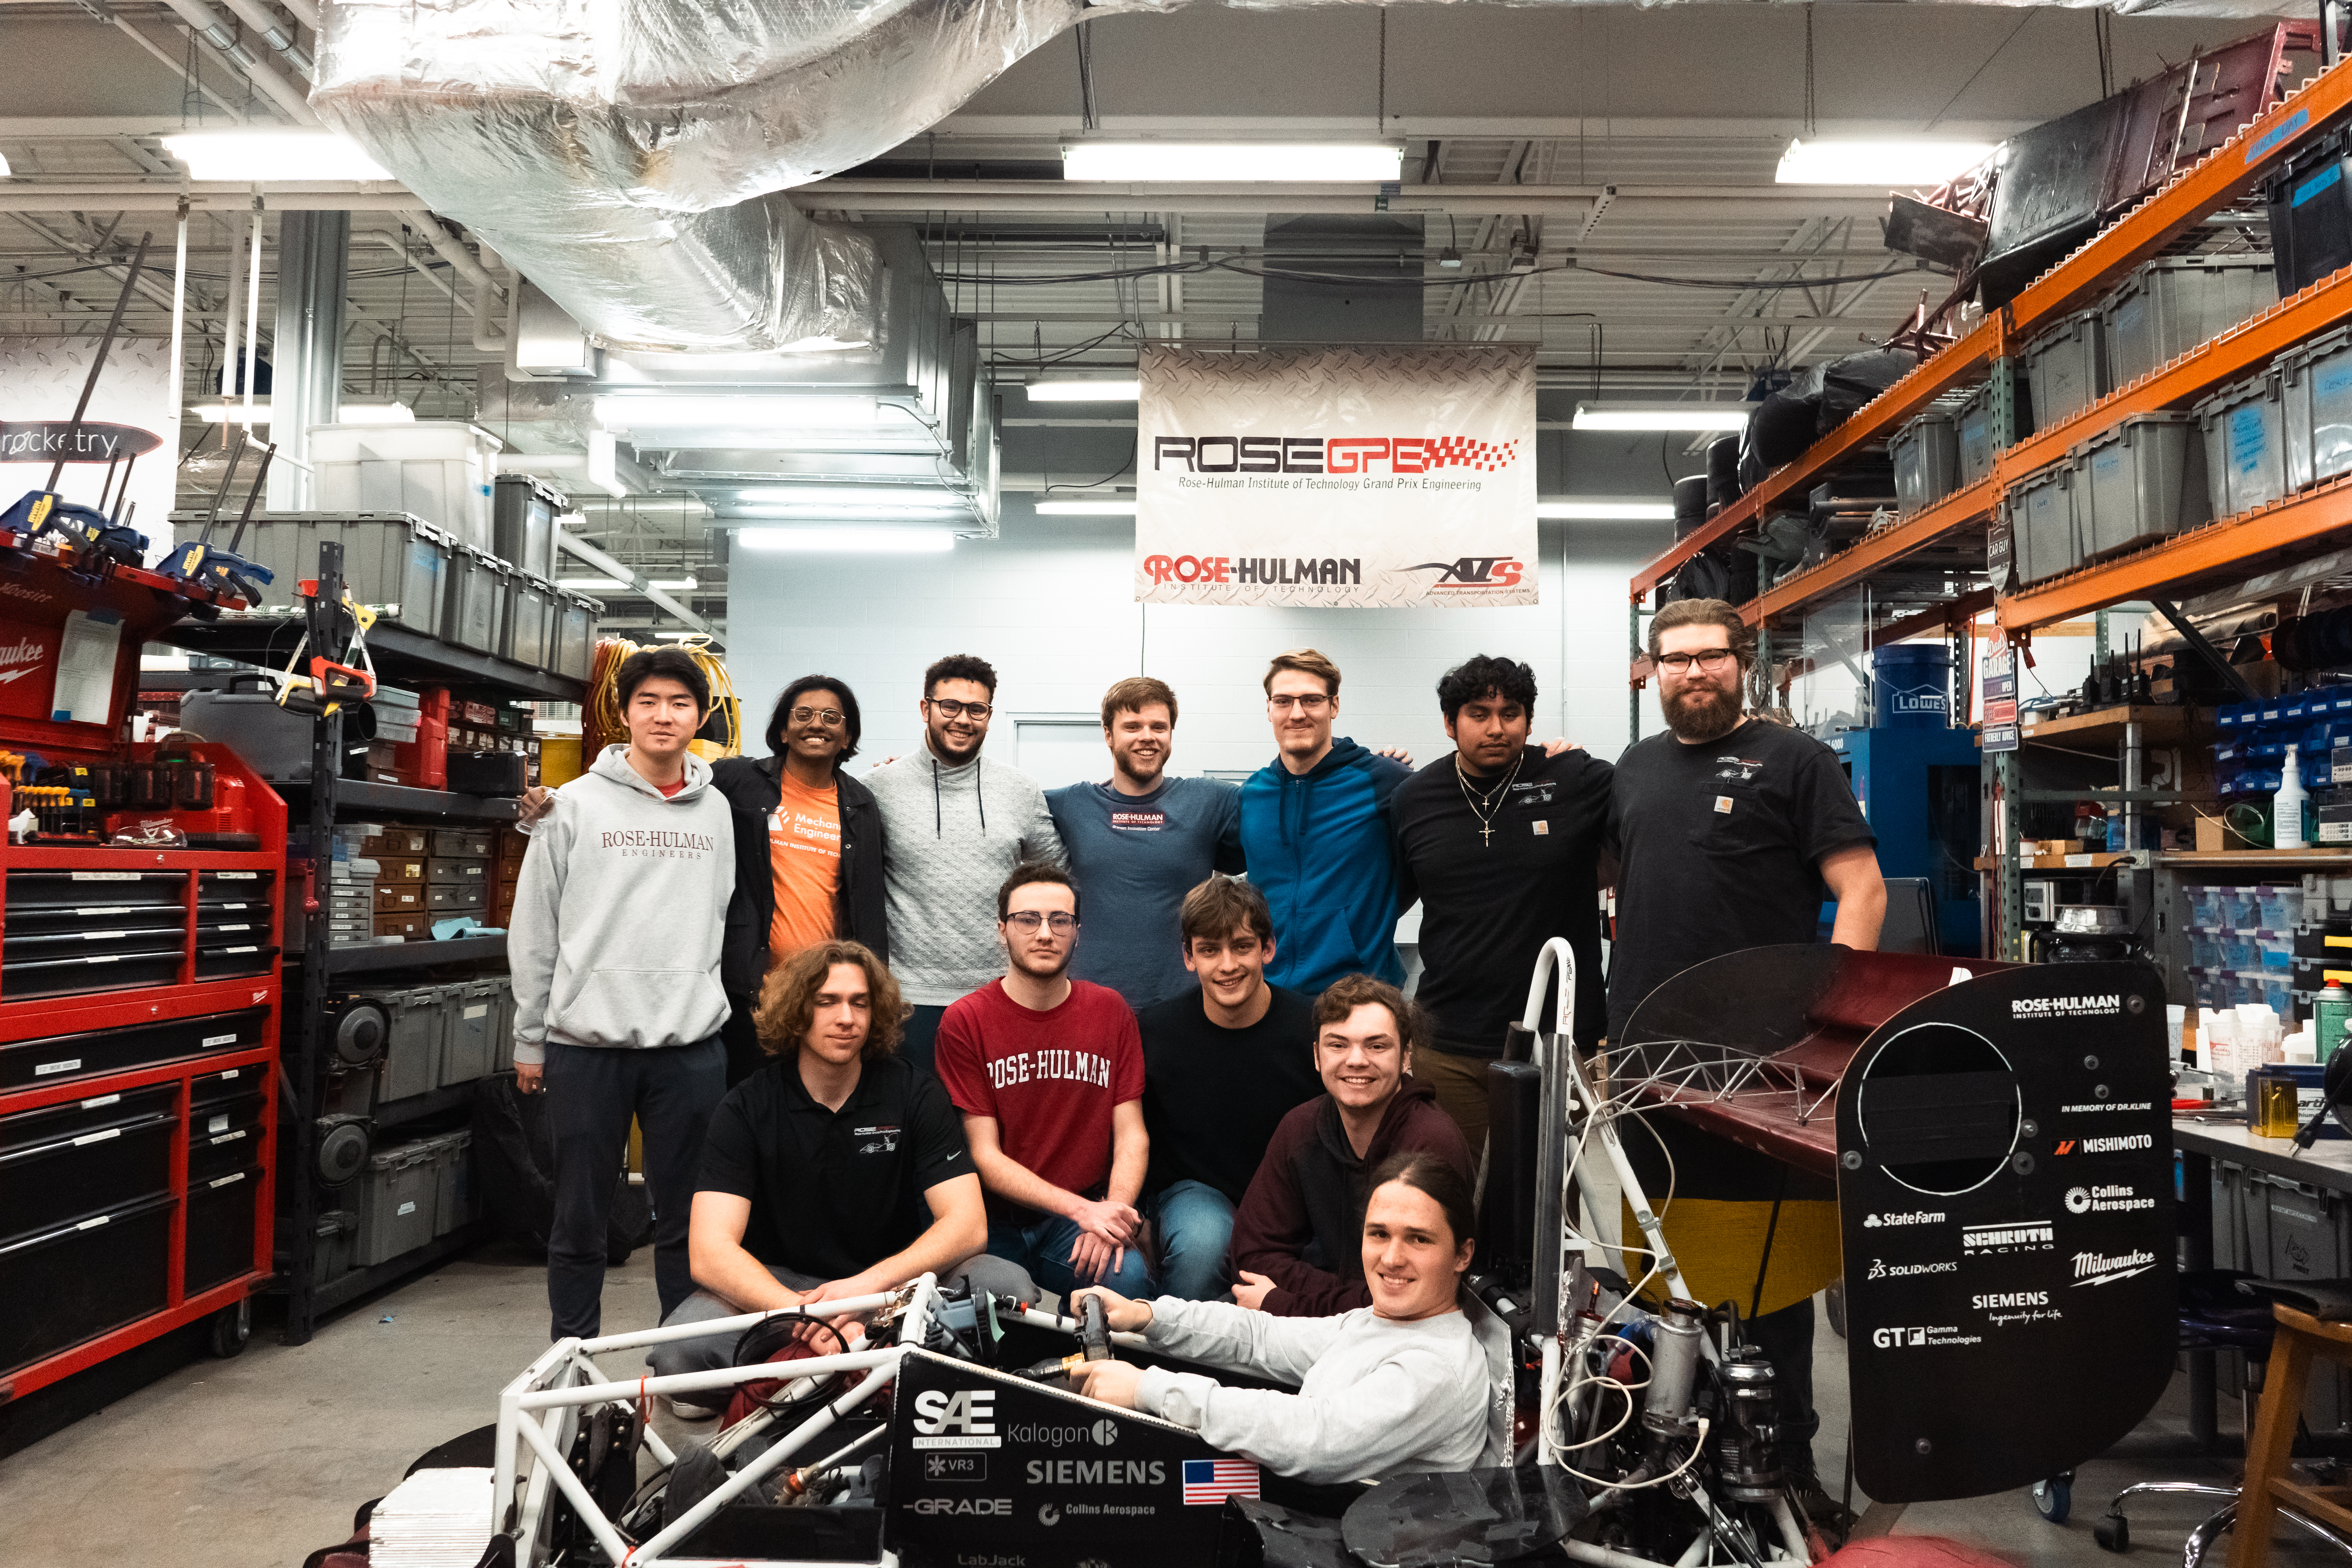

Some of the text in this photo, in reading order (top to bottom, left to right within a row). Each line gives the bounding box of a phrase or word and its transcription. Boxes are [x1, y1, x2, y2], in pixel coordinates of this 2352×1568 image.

[1179, 477, 1481, 492] Rose-Hulman Institute of Technology Grand Prix Engineering
[1989, 538, 2009, 557] CAR GUY
[182, 550, 195, 570] IRWIN
[1144, 555, 1361, 585] ROSE-HULMAN
[1164, 584, 1359, 594] INSTITUTE OF TECHNOLOGY
[1987, 632, 2005, 656] Dad's
[1984, 654, 2011, 679] GARAGE
[2002, 681, 2012, 693] OPEN
[1985, 729, 2015, 743] FATHERLY ADVICE
[1831, 738, 1844, 750] 6000
[601, 830, 713, 852] ROSE-HULMAN
[789, 843, 817, 853] INSTITUTE
[622, 849, 702, 860] ENGINEERS
[2011, 995, 2120, 1013] ROSE-HULMAN
[2068, 1008, 2120, 1016] TECHNOLOGY
[2071, 1104, 2105, 1112] MEMORY
[2118, 1103, 2152, 1111] DR.KLINE
[2083, 1134, 2152, 1153] MISHIMOTO
[2092, 1185, 2133, 1198] Collins
[2092, 1199, 2154, 1212] Aerospace
[1883, 1211, 1945, 1226] StateFarm
[1963, 1228, 2054, 1247] SCHROTH
[1964, 1244, 2054, 1255] RACING
[1889, 1261, 1957, 1276] SOLIDWORKS
[2070, 1249, 2155, 1278] Milwaukee
[1972, 1291, 2049, 1309] SIEMENS
[1989, 1309, 2062, 1327] Ingenuity for life
[1873, 1325, 1958, 1348] GT Gamma
[1927, 1335, 1982, 1346] Technologies
[913, 1390, 996, 1434] SAE
[914, 1437, 995, 1447] INTERNATIONAL
[1008, 1422, 1089, 1447] Kalogon
[948, 1459, 974, 1471] VR3
[1027, 1459, 1166, 1485] SIEMENS
[1066, 1504, 1156, 1516] Collins Aerospace
[958, 1553, 1025, 1566] LabJack
